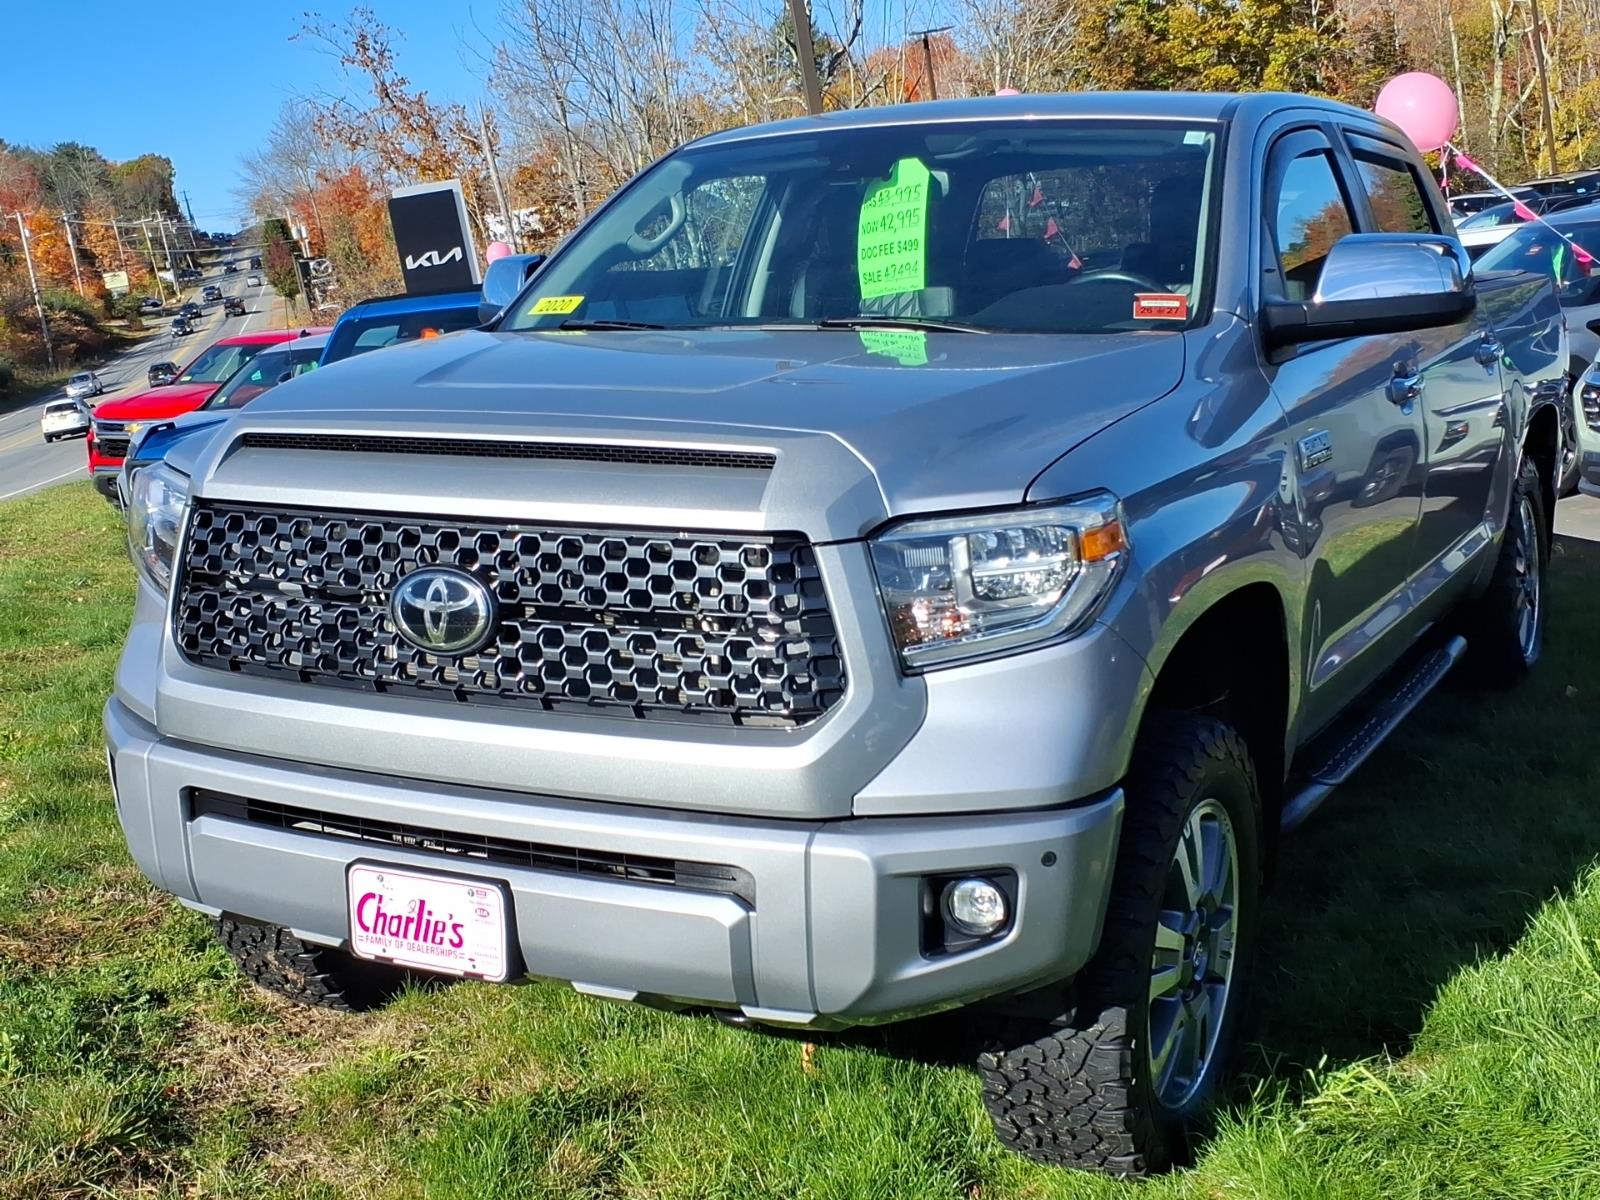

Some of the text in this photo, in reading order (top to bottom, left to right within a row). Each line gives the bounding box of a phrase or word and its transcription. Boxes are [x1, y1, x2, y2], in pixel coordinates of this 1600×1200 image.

[861, 207, 921, 235] NOW 42,995
[405, 246, 463, 270] KIA
[897, 238, 919, 254] $499
[863, 270, 882, 285] SALE
[538, 298, 573, 312] 2020
[357, 892, 464, 949] Charlie's
[365, 935, 458, 959] FAMILY OF DEALERSHIPS
